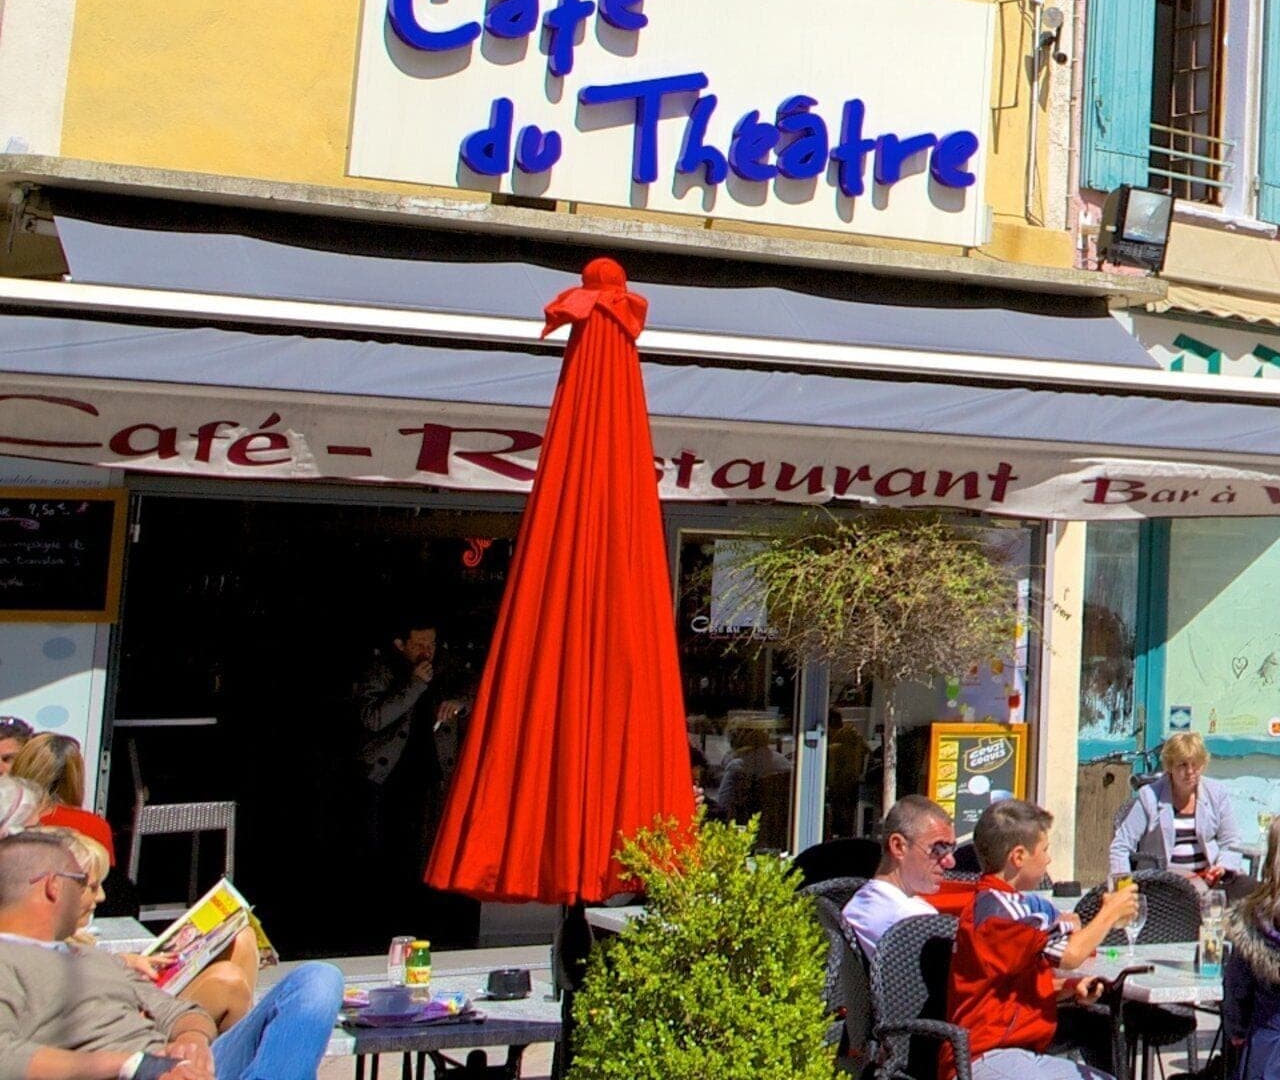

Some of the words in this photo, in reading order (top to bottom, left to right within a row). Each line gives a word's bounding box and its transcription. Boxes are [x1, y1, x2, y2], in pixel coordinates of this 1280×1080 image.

[460, 97, 562, 176] du
[578, 72, 979, 198] Théâtre
[0, 394, 293, 466] Café
[398, 422, 1019, 504] Rtaurant
[1081, 477, 1200, 505] Bar
[1211, 485, 1238, 504] à
